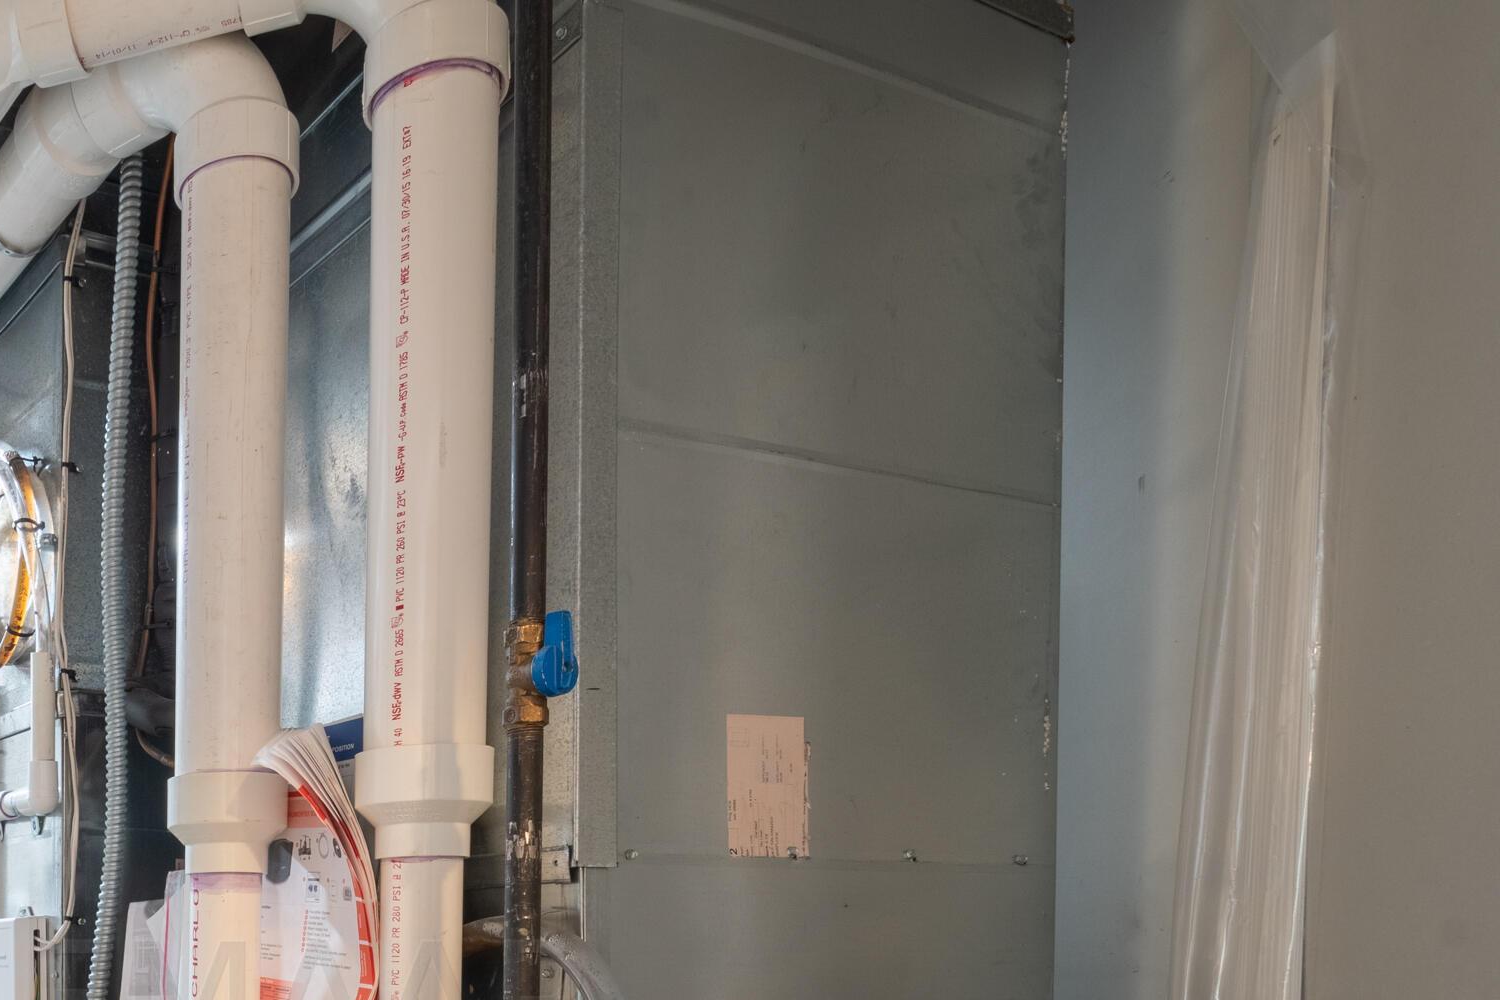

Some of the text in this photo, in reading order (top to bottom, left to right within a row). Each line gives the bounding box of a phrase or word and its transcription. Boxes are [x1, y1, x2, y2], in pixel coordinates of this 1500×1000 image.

[401, 251, 411, 263] IN
[400, 265, 411, 286] MADE
[396, 535, 406, 552] 260
[396, 553, 405, 565] PR
[395, 586, 405, 602] PVC
[394, 628, 404, 648] 2665
[392, 905, 401, 923] 280
[391, 927, 401, 939] PR
[391, 968, 400, 986] PVC
